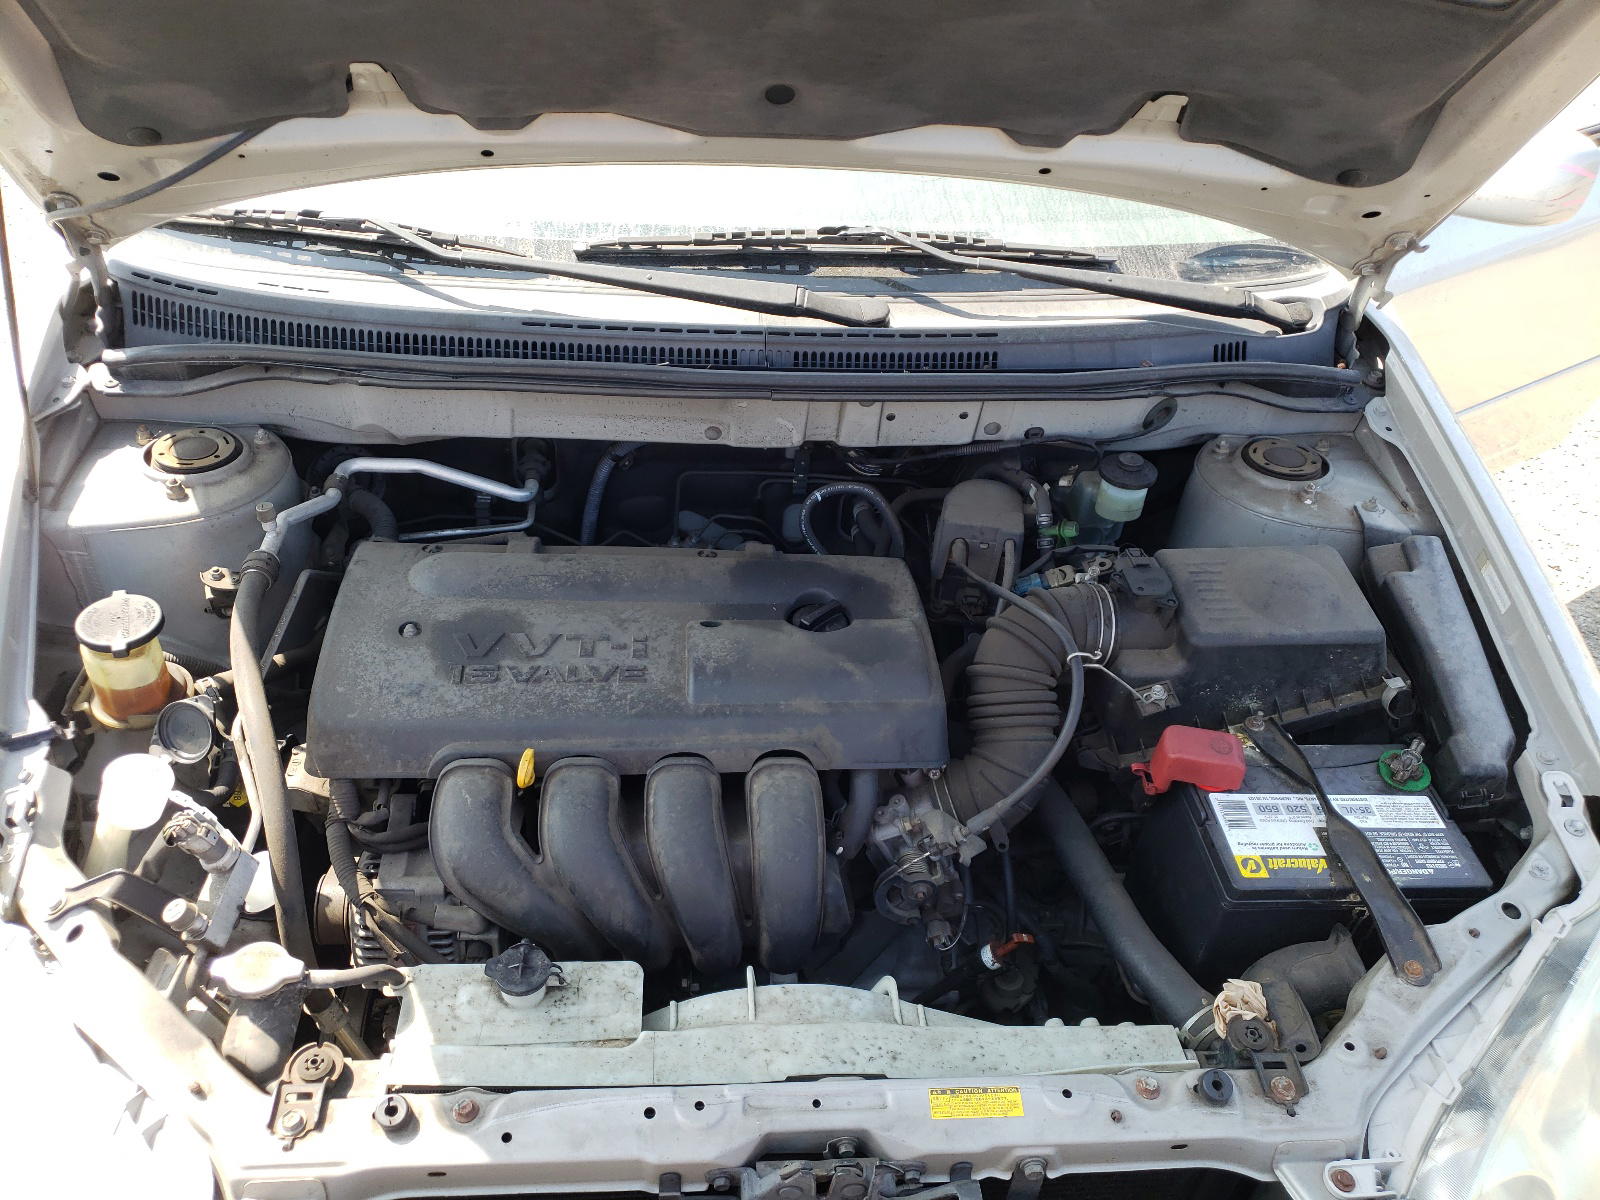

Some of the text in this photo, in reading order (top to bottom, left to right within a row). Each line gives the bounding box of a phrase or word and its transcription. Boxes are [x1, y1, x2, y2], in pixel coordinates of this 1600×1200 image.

[1258, 805, 1280, 813] 650
[1286, 805, 1307, 813] 520
[1341, 806, 1373, 814] 35-VL
[1267, 858, 1328, 874] Valucraft
